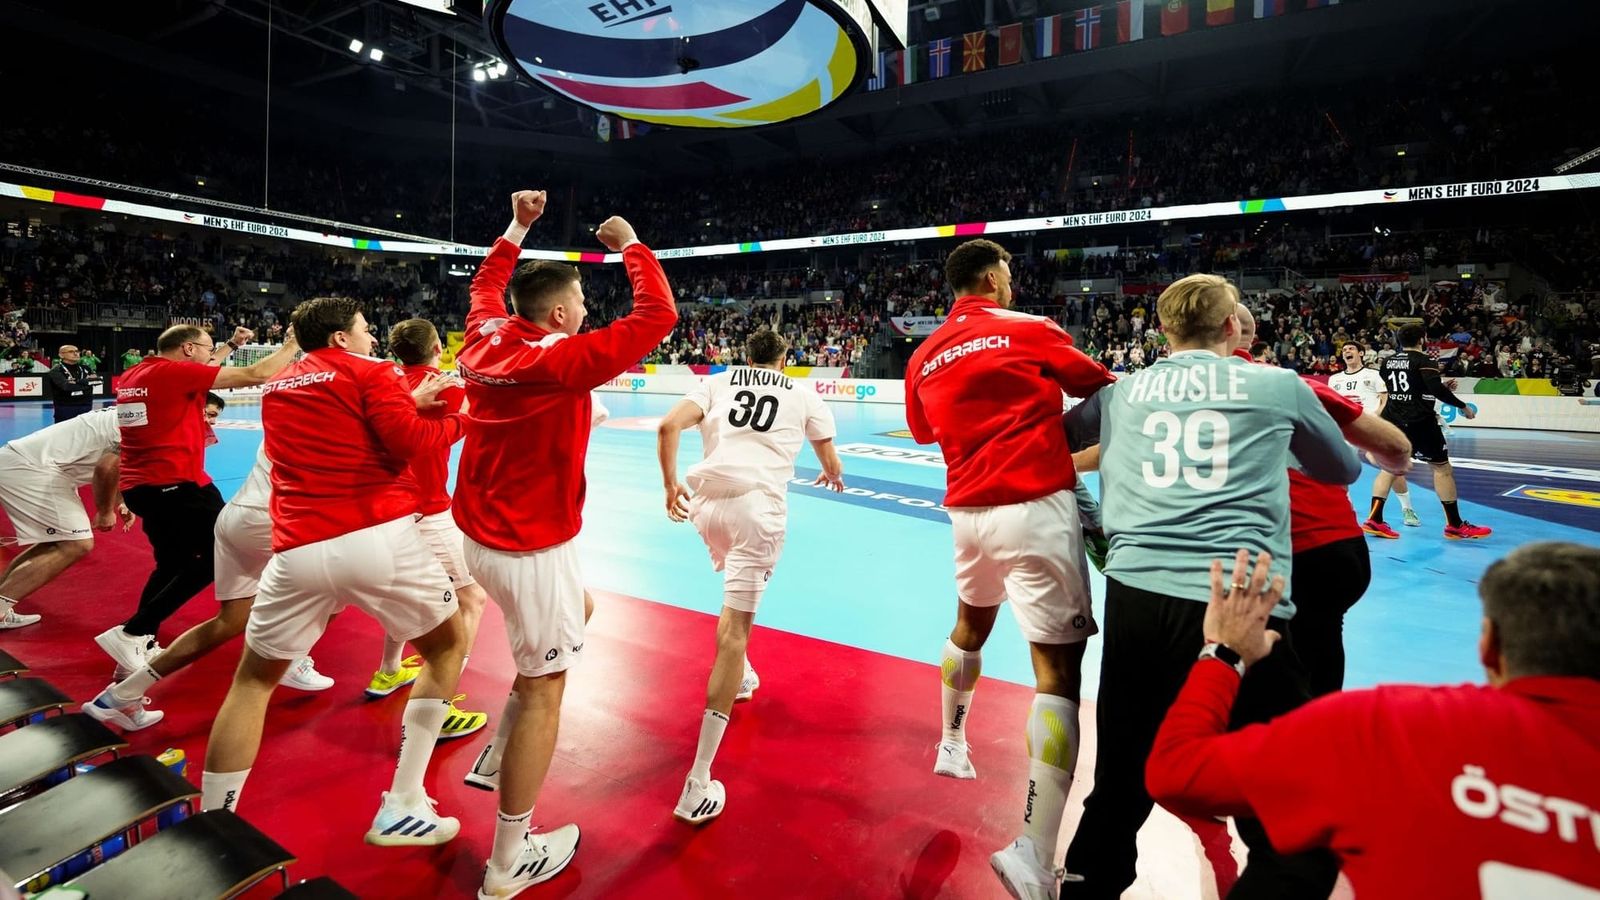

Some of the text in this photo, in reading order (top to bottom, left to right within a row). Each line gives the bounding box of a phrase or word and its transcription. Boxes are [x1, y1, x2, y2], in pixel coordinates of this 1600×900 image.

[1446, 184, 1467, 198] EHF
[1471, 182, 1502, 196] EURO
[1506, 179, 1540, 193] 2024
[203, 216, 288, 237] MENS EHF EURO 2024
[1062, 210, 1152, 226] MENS EHF EURO 2024
[869, 232, 886, 242] 2024
[921, 335, 1010, 377] ÖSTERREICH
[262, 370, 337, 397] STERREICH
[815, 380, 876, 400] trivago
[1127, 363, 1249, 403] HÄUSLE
[1346, 381, 1358, 391] 97
[1388, 370, 1410, 392] 18
[728, 390, 779, 433] 30
[1141, 409, 1231, 491] 39
[951, 704, 965, 730] Kempa
[1024, 779, 1036, 824] Kempa
